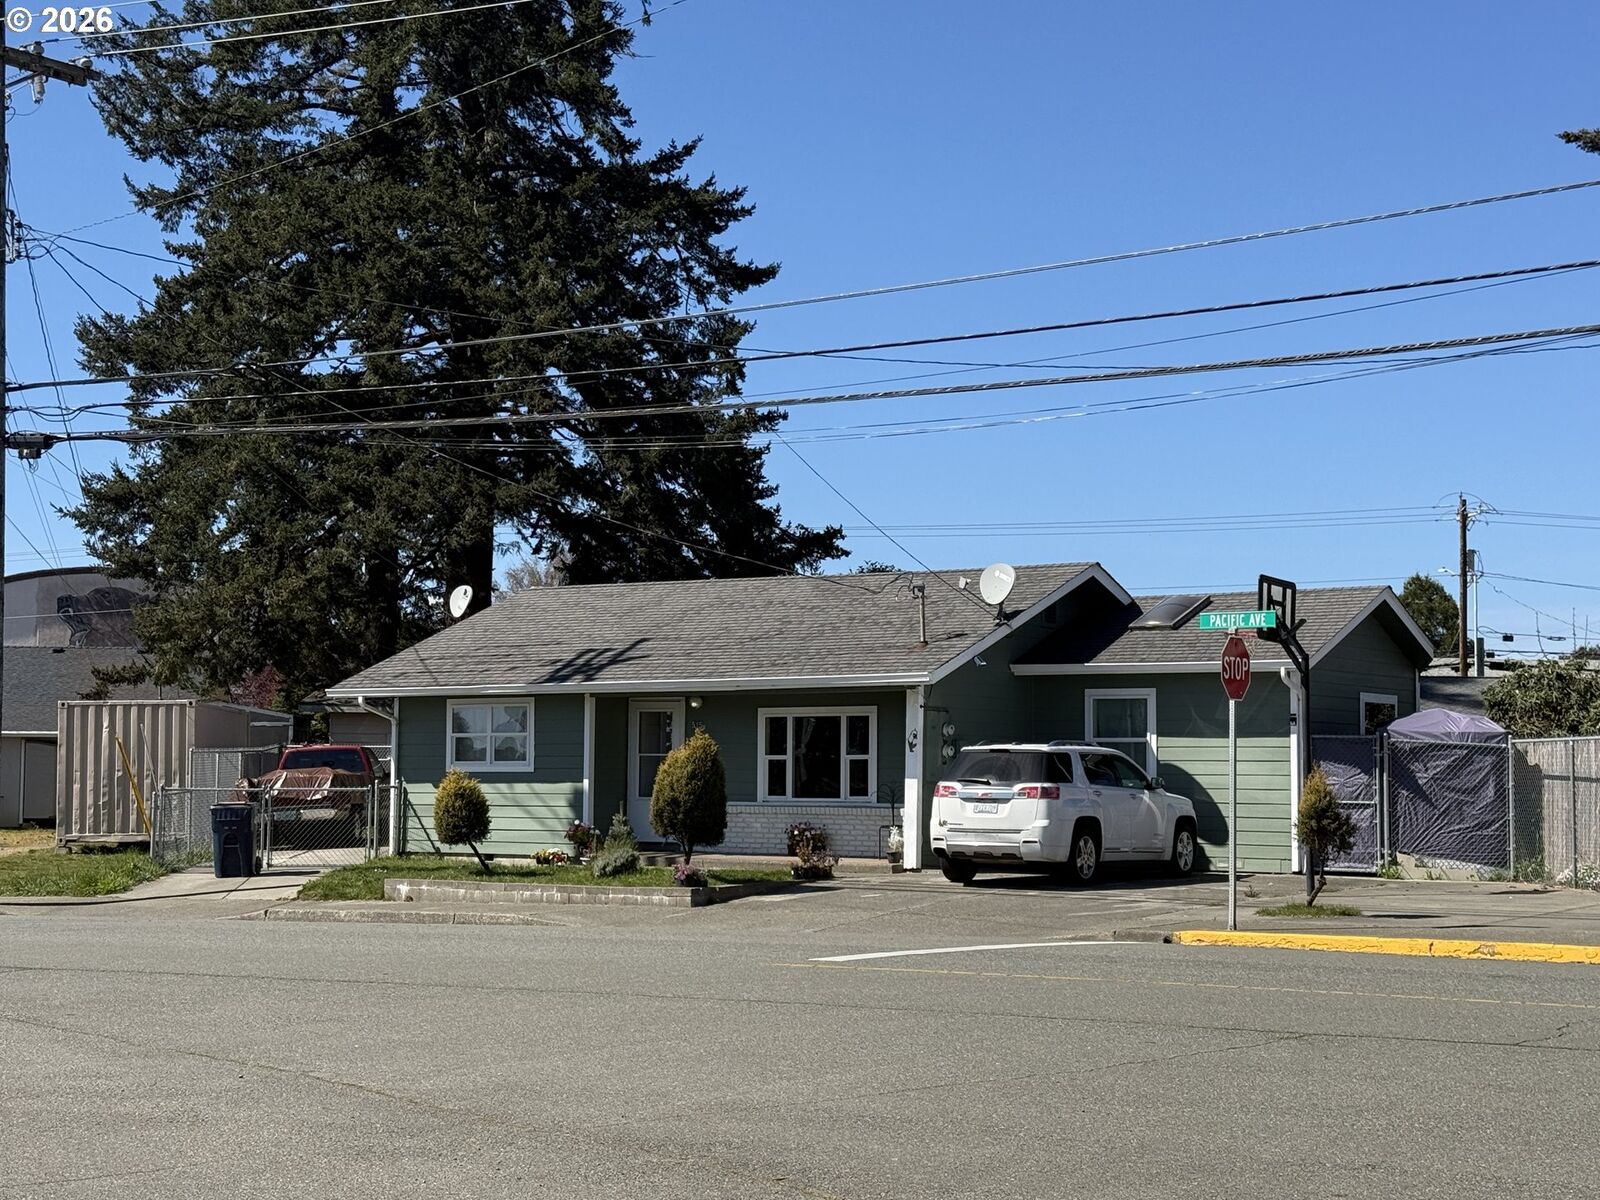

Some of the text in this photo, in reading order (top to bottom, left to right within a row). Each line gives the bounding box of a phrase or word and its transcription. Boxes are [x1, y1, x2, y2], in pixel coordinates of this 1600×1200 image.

[1209, 613, 1266, 627] PACIFIC AVE
[1223, 656, 1248, 680] STOP
